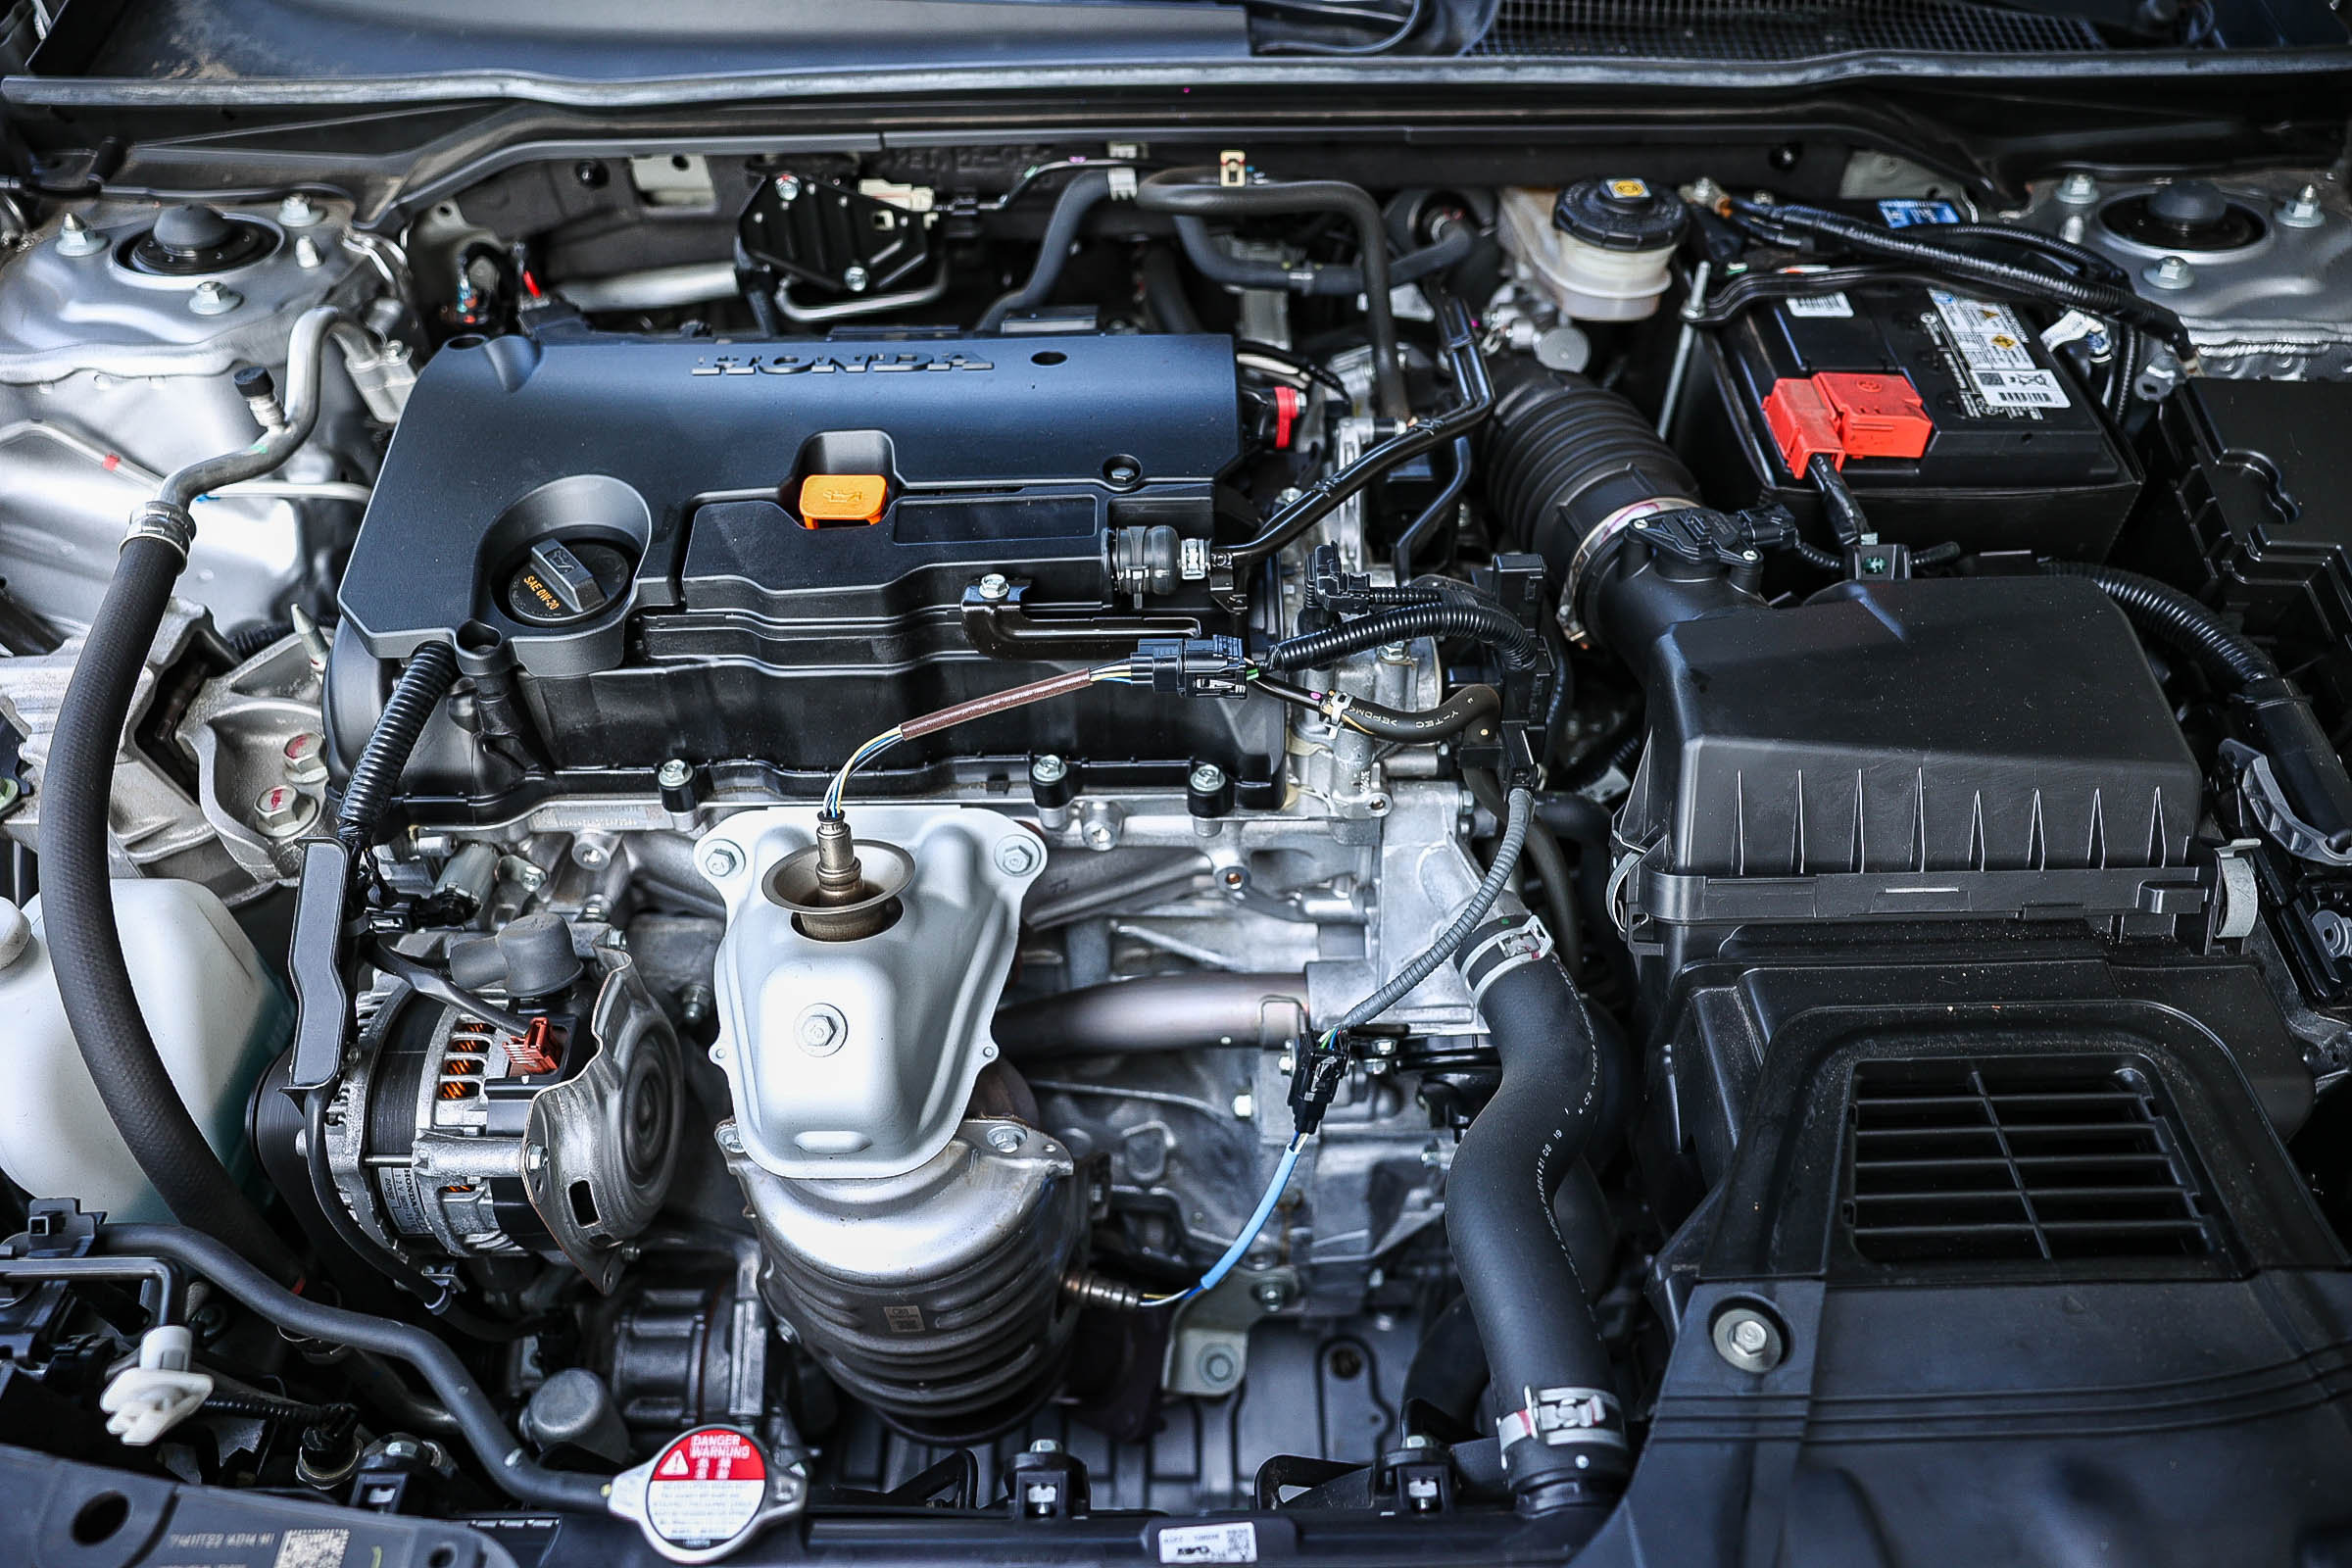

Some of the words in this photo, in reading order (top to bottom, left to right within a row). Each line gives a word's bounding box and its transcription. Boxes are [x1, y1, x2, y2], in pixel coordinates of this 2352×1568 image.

[692, 353, 995, 375] HONDA
[523, 575, 542, 592] SAE
[536, 587, 562, 611] 0W-20
[1415, 710, 1459, 729] Y-TEC
[404, 1169, 417, 1207] HONDA
[690, 1435, 741, 1446] DANGER
[689, 1446, 751, 1459] WARNUNG
